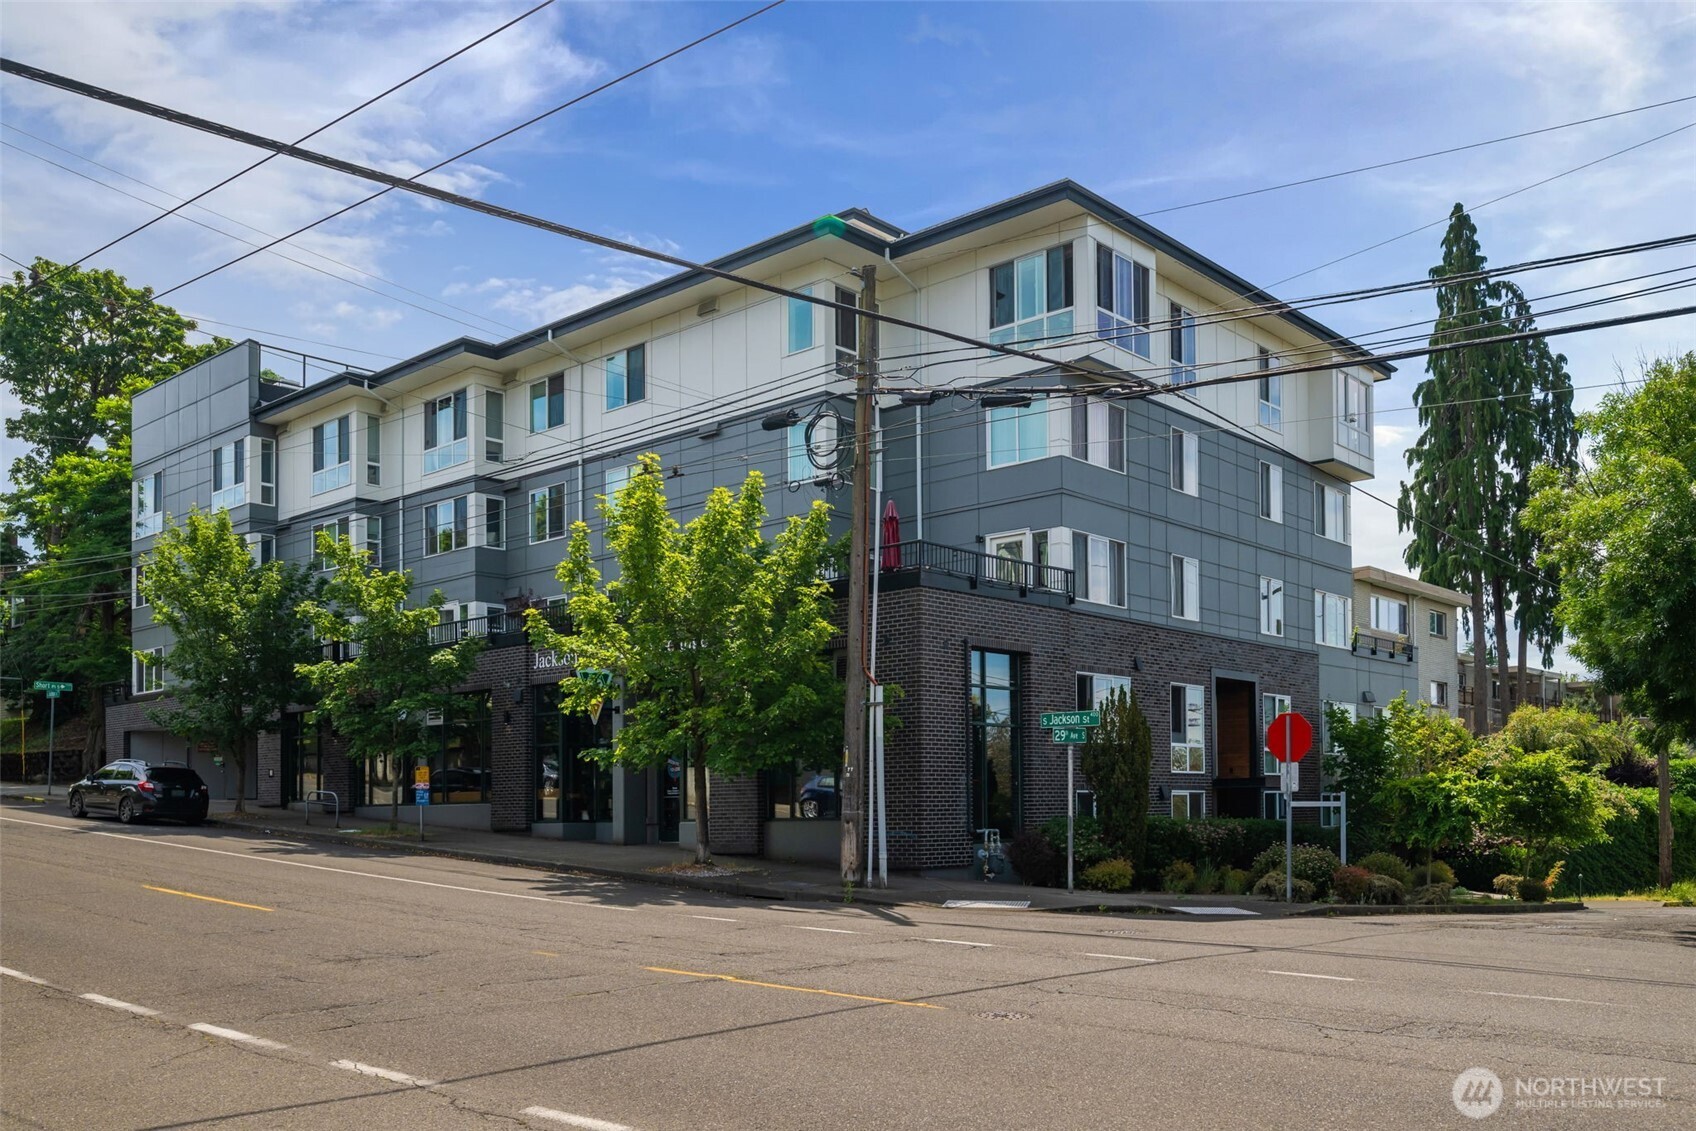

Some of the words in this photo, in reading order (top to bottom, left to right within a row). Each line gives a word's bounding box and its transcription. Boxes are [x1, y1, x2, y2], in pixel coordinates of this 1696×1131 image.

[1042, 717, 1048, 725] S
[1049, 714, 1080, 725] Jackson
[1082, 715, 1090, 723] St
